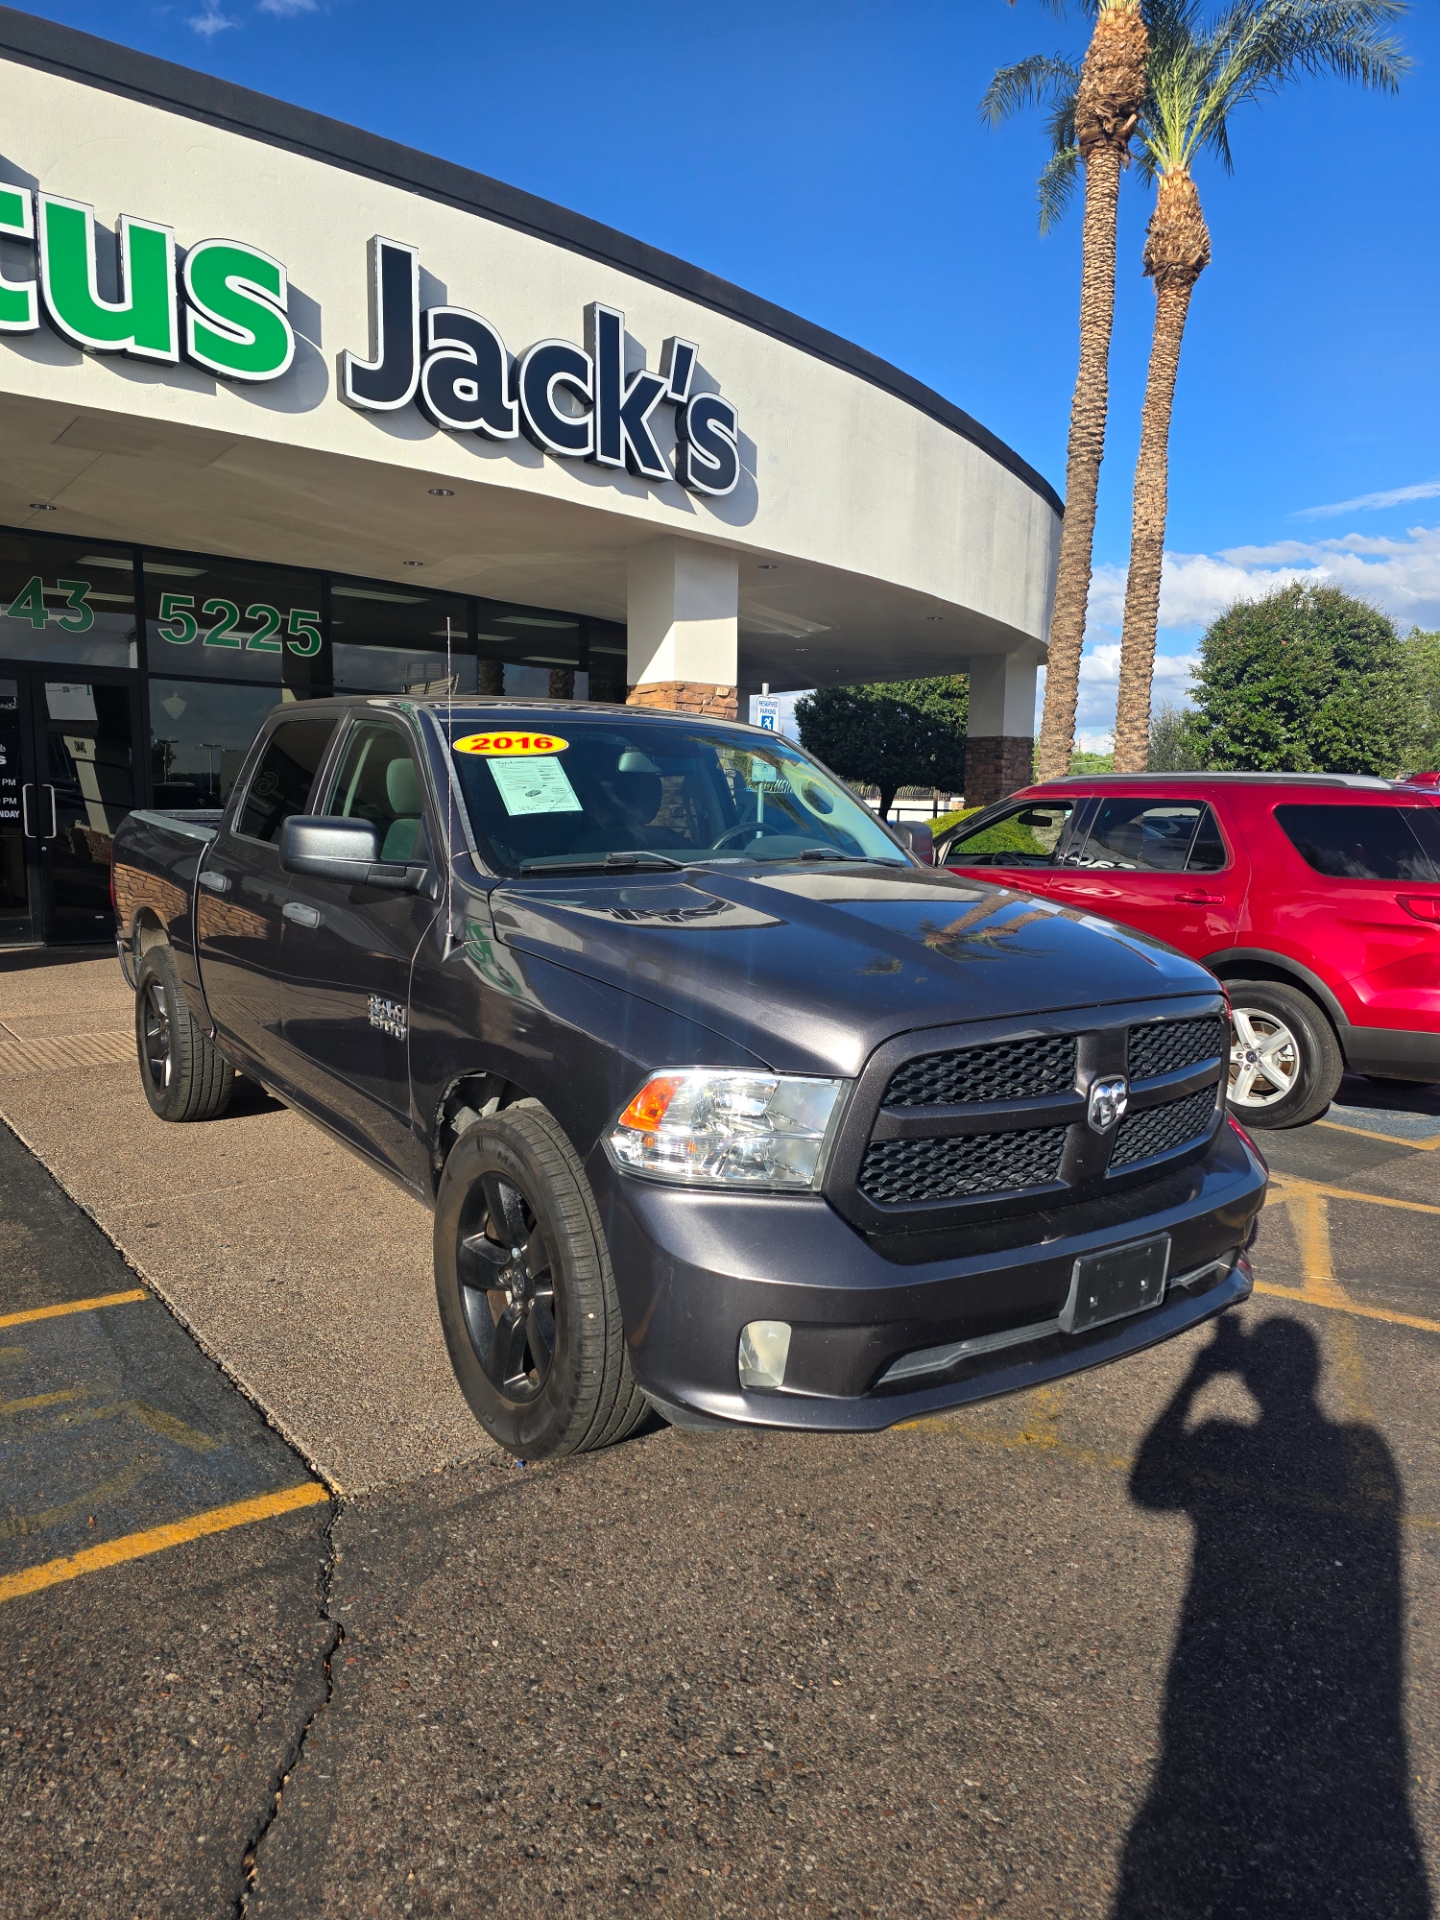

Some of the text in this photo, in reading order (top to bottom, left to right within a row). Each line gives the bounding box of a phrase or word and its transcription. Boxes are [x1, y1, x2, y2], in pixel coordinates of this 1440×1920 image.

[338, 234, 742, 497] Jack's
[6, 576, 323, 657] 43 5225
[758, 700, 778, 708] RESERVED
[759, 707, 777, 715] PARKING
[470, 737, 553, 750] 2016
[2, 778, 16, 786] PM
[2, 797, 17, 805] PM
